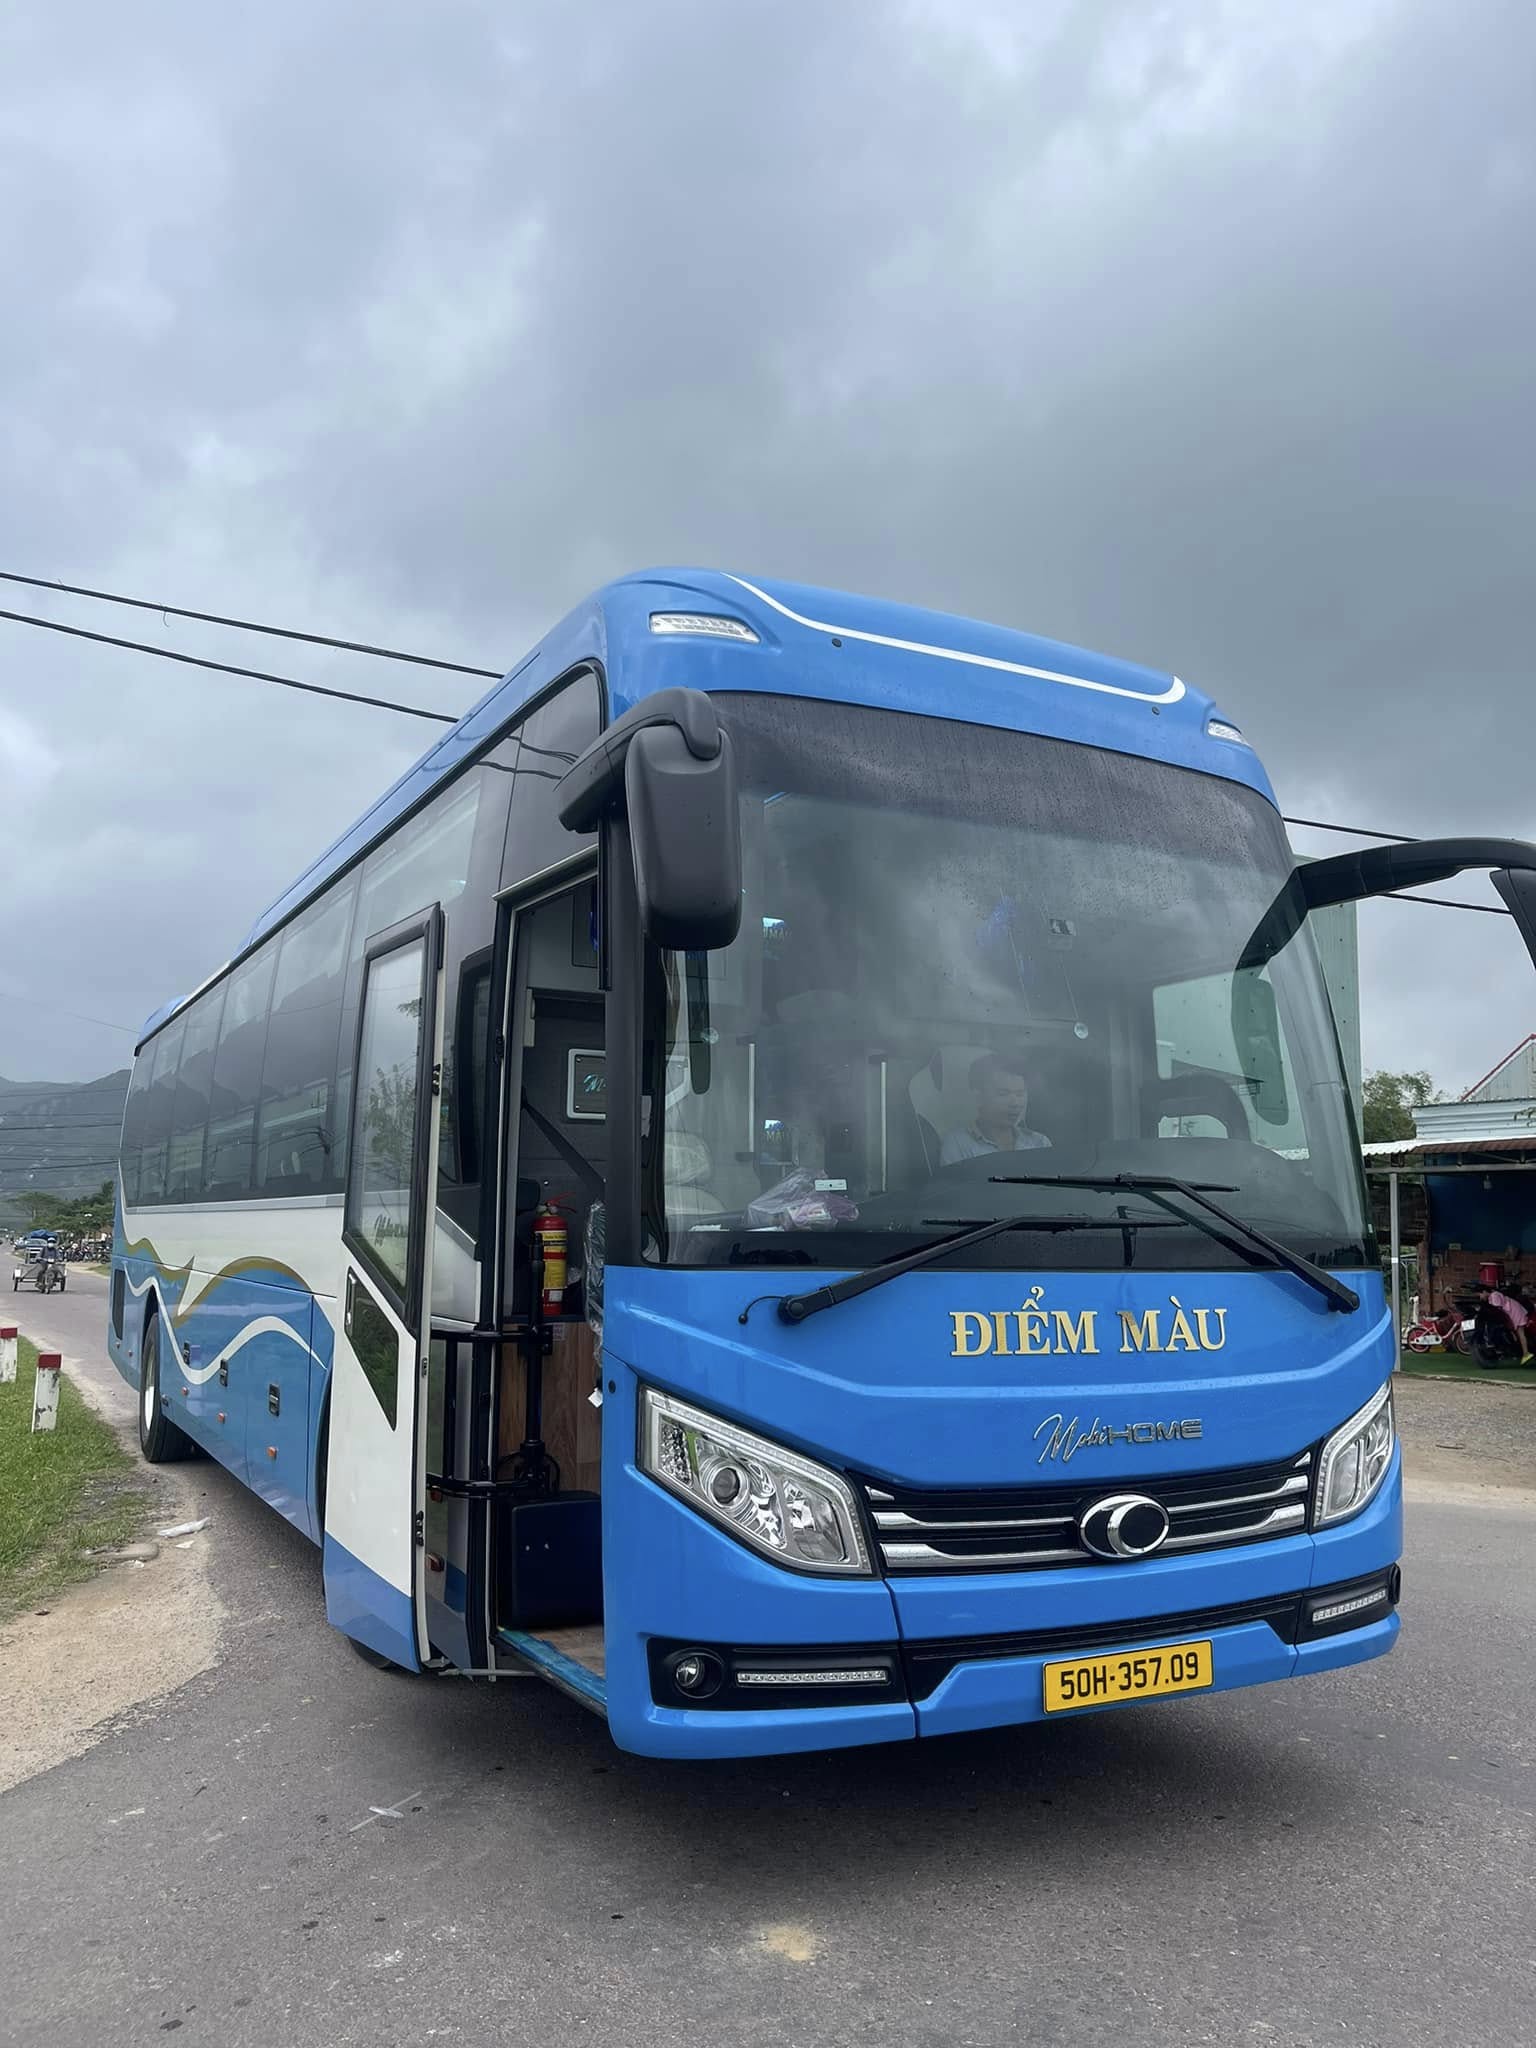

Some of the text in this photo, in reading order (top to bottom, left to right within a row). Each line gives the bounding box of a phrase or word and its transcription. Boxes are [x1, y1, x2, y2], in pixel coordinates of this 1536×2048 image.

[949, 1286, 1228, 1356] ĐIỂM MÀU
[1060, 1652, 1199, 1700] 50H-357.09
